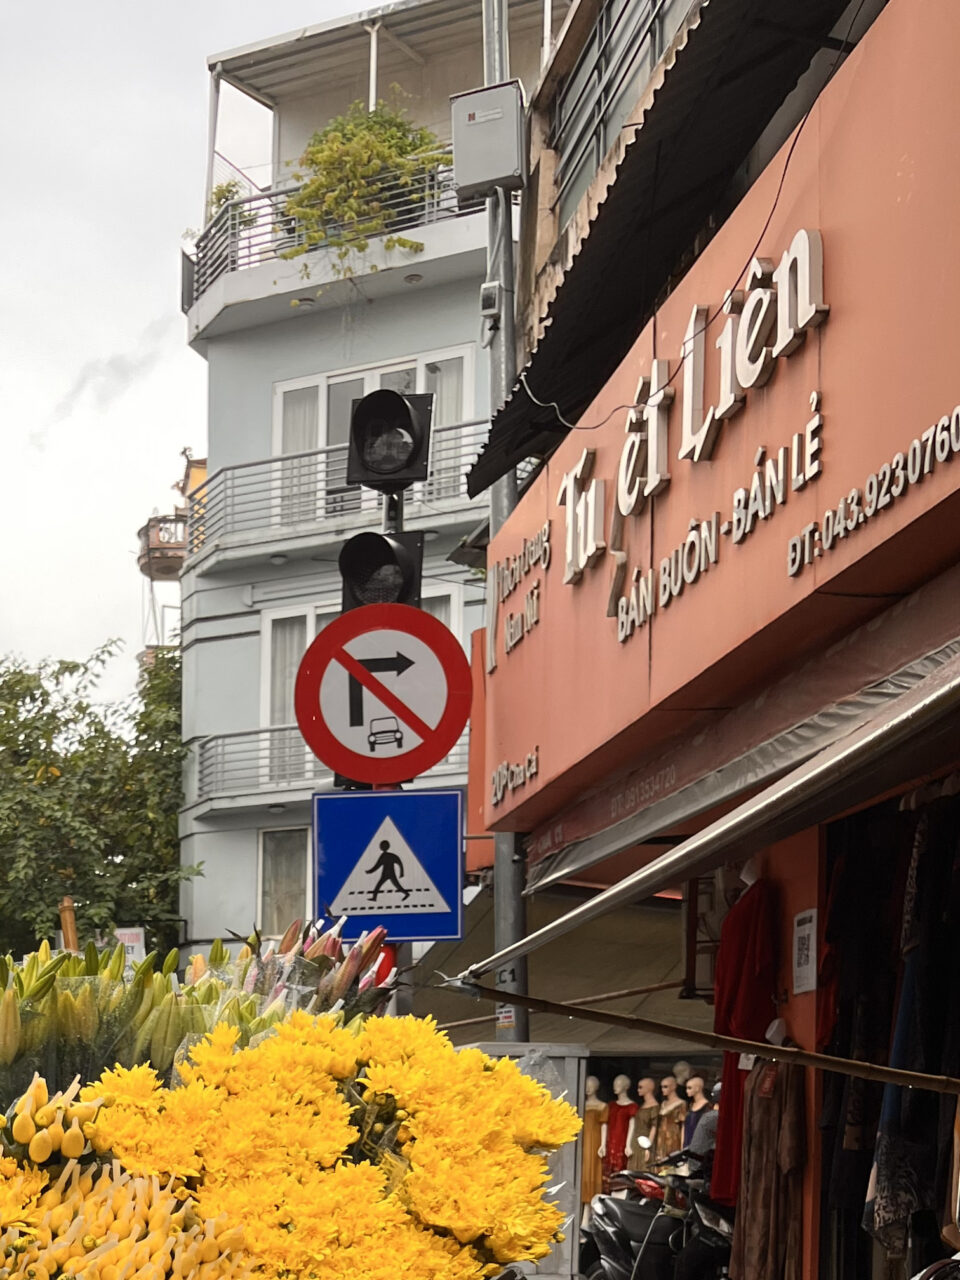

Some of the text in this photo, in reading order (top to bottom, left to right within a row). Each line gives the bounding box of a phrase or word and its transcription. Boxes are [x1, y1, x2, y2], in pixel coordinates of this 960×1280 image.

[678, 228, 829, 462] Liên
[617, 567, 654, 643] BÁN
[659, 512, 720, 607] BUÔN
[732, 445, 788, 544] BÁN
[792, 391, 824, 491] LẺ
